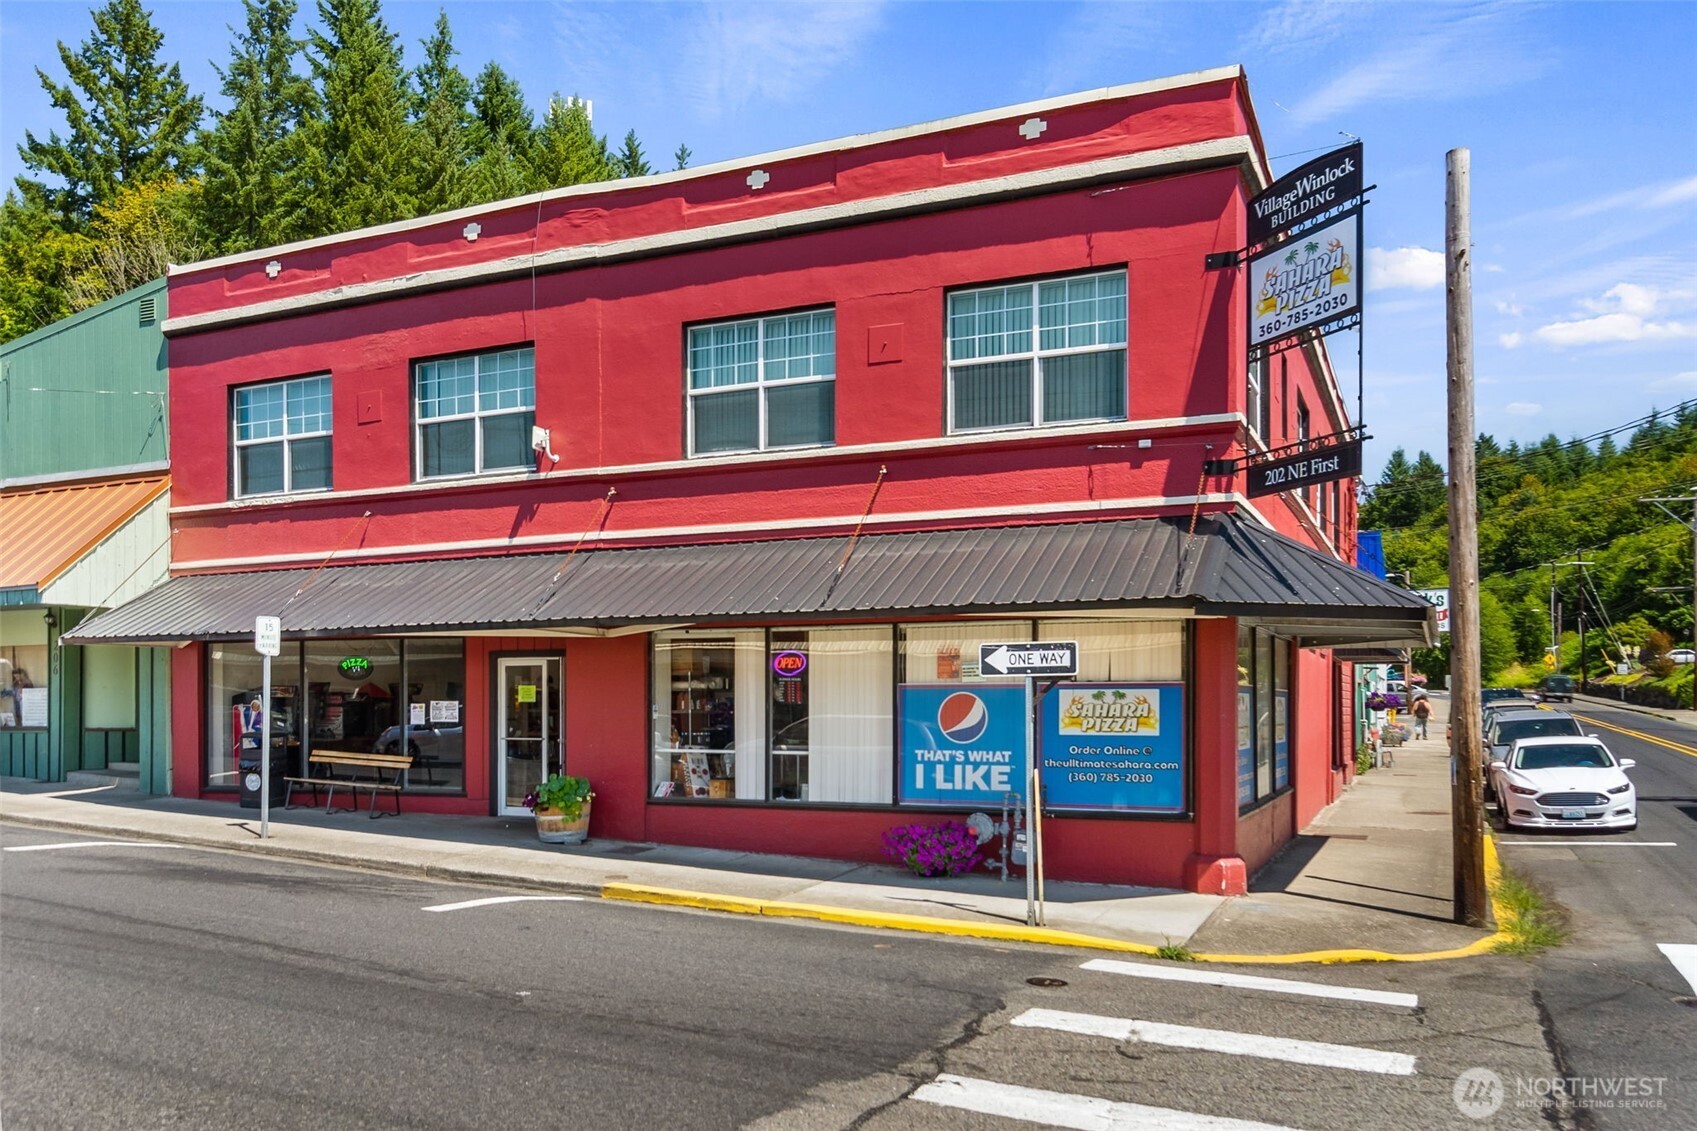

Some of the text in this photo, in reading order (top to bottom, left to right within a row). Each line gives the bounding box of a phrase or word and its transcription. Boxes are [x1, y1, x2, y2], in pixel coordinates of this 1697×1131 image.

[1271, 186, 1336, 228] BUILDING
[1263, 246, 1344, 300] SAHARA
[1274, 274, 1333, 317] PIZZA
[1259, 293, 1348, 338] 360-785-2030
[1264, 455, 1340, 486] 202 NE First
[265, 623, 274, 632] 15
[341, 658, 369, 670] PIZZA
[777, 657, 802, 669] OPEN
[1008, 652, 1066, 666] ONE WAY
[1069, 702, 1151, 718] SAHARA
[1080, 717, 1139, 733] PIZZA
[914, 749, 1012, 763] THAT'S WHAT
[1069, 745, 1101, 755] Order
[1103, 746, 1140, 756] Online
[915, 763, 1012, 791] I LIKE
[1068, 773, 1153, 783] (360) 785-2030
